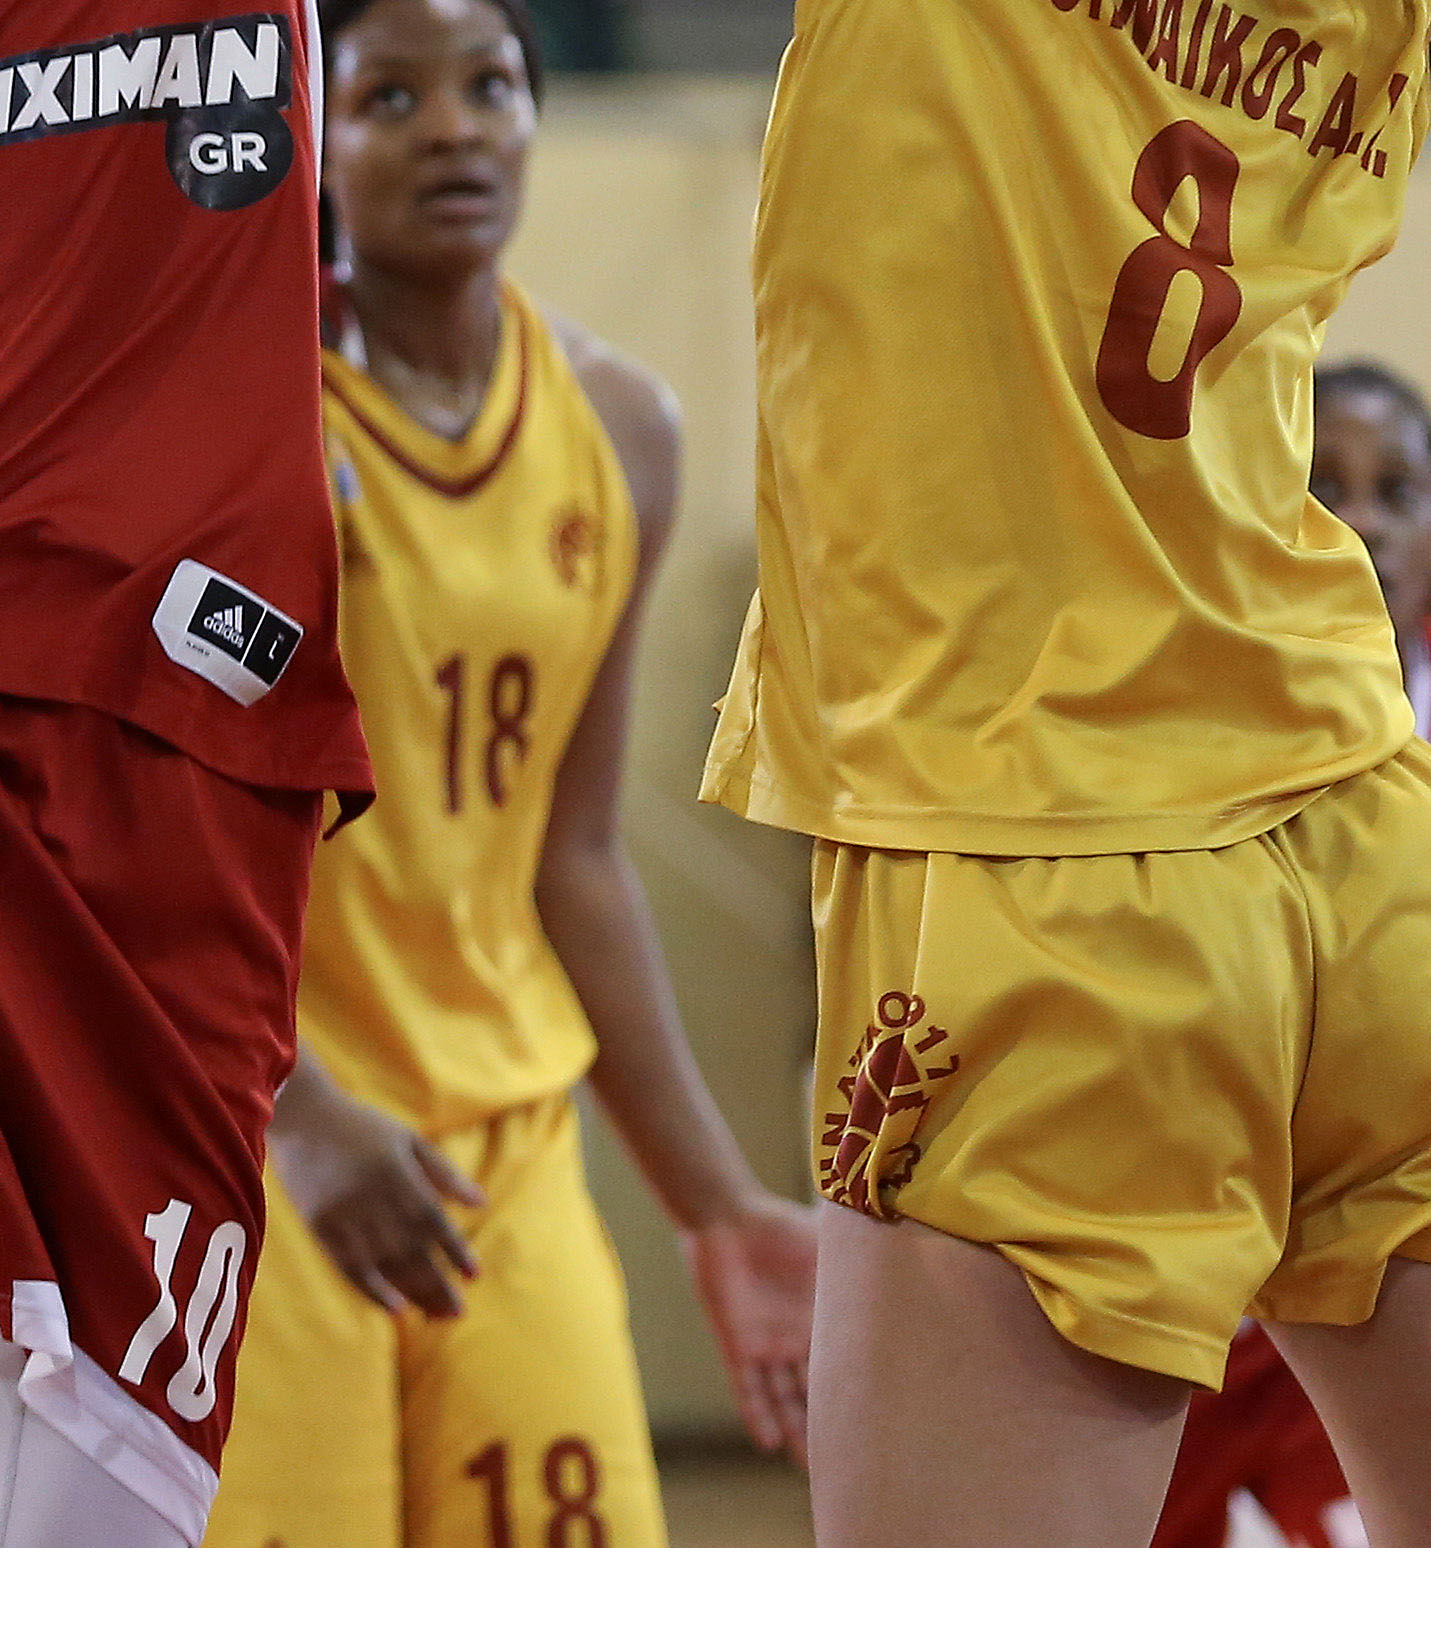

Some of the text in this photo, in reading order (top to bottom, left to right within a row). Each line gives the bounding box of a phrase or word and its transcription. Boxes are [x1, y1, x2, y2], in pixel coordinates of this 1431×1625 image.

[188, 132, 267, 175] GR
[1096, 119, 1242, 440] 8
[204, 615, 244, 649] adidas
[436, 651, 534, 816] 18
[118, 1198, 246, 1422] 10
[464, 1436, 608, 1547] 18
